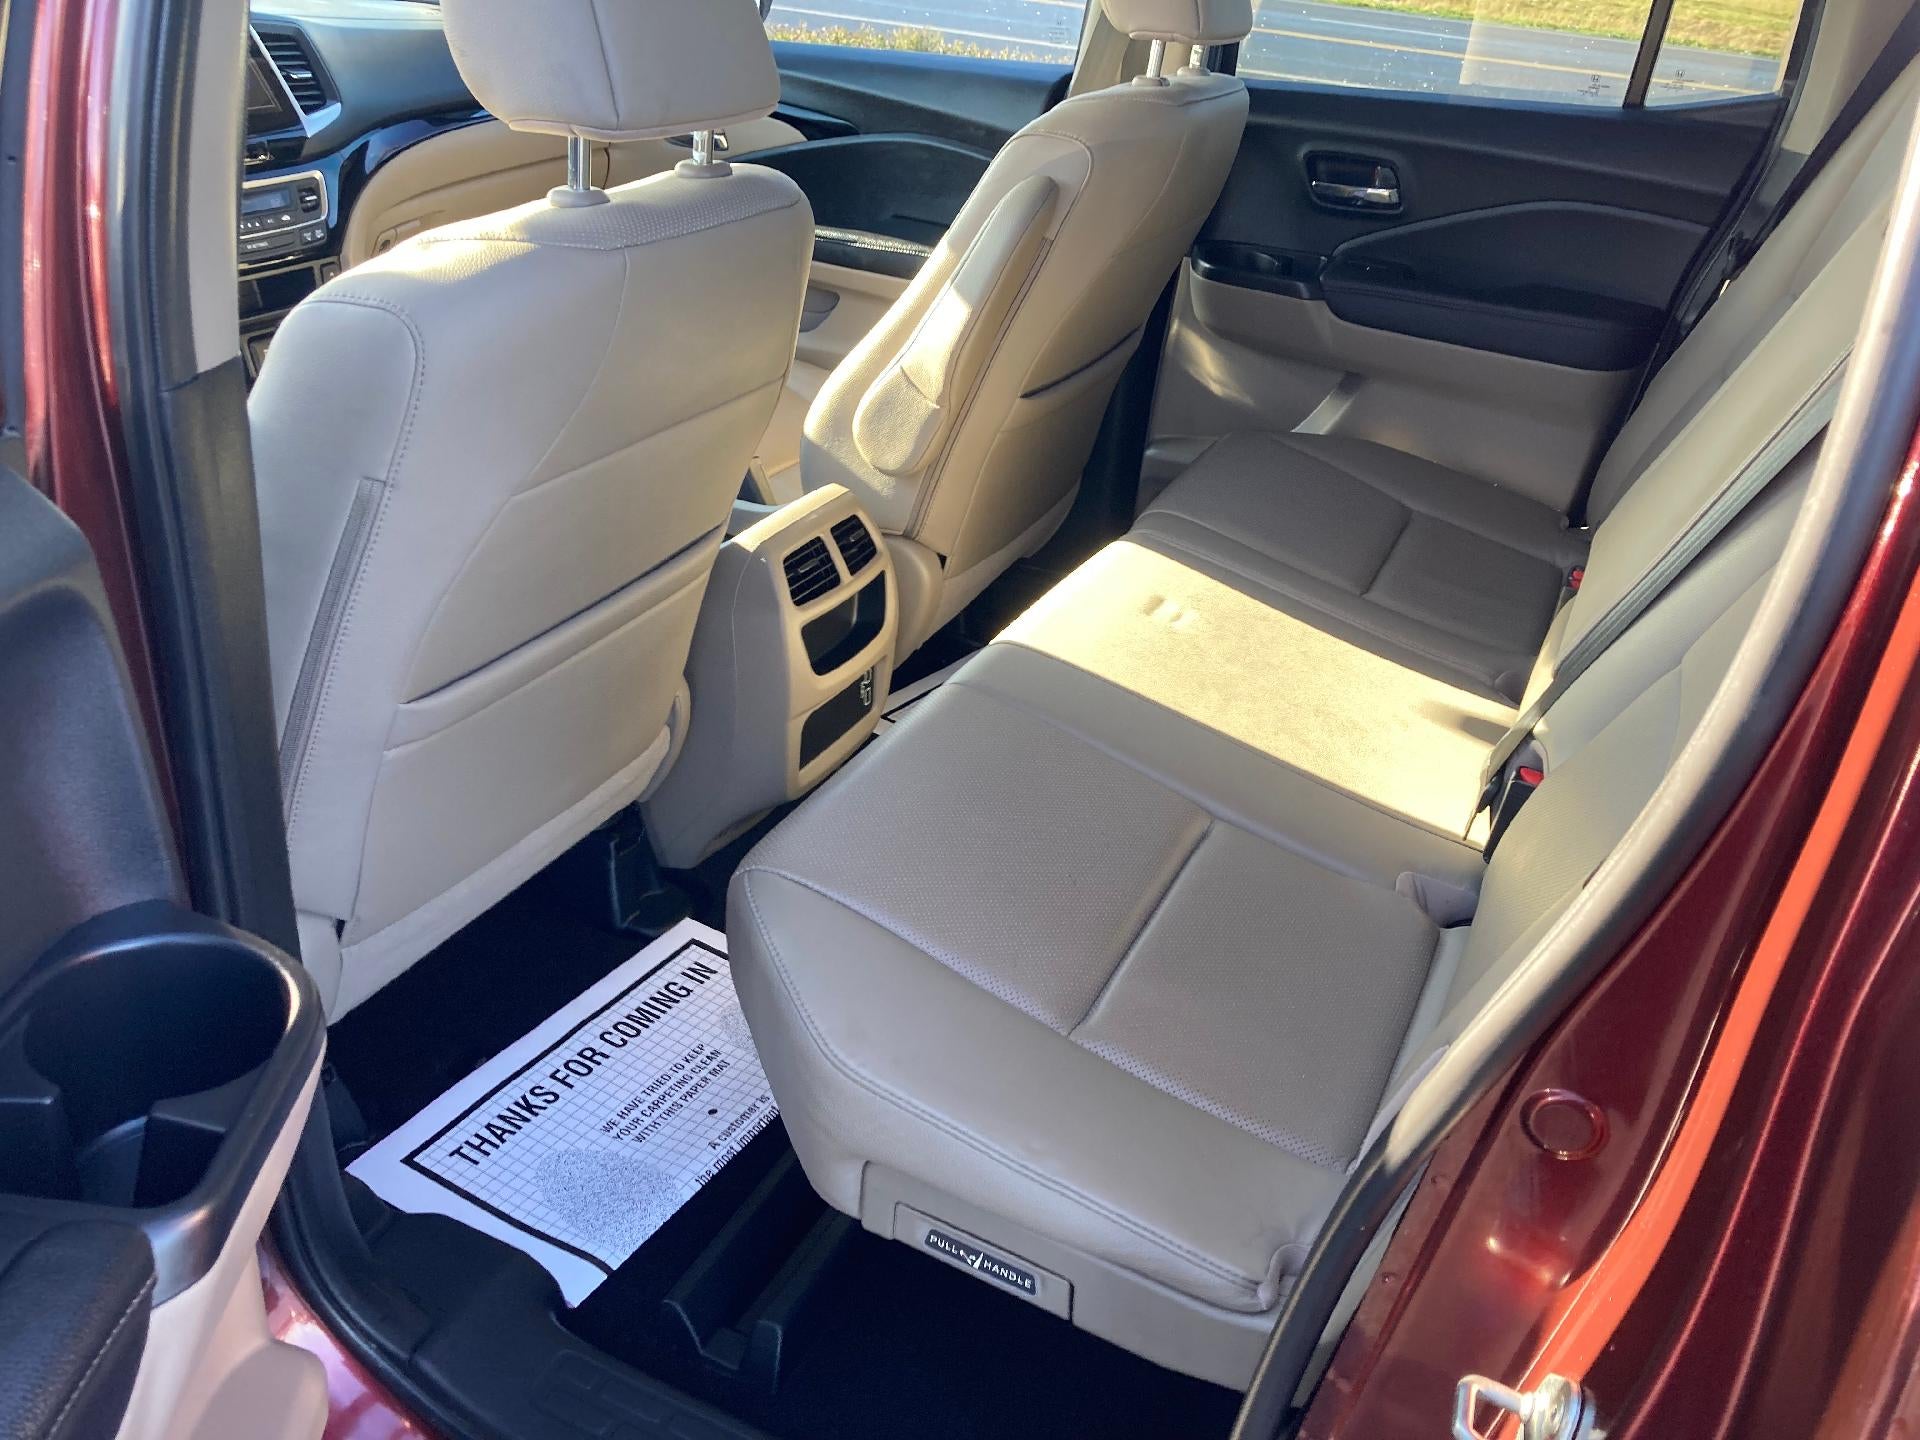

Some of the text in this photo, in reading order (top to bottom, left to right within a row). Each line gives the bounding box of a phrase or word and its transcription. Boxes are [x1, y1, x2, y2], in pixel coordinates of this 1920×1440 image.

[450, 961, 718, 1165] THANKS FOR COMING IN
[600, 1043, 706, 1133] WE HAVE TRIED TO KEEP
[612, 1049, 722, 1141] YOUR CARPETING CLEAN
[633, 1059, 730, 1143] WITH THIS PAPER MAT
[695, 1105, 780, 1185] the most important
[708, 1094, 770, 1150] A customer is
[930, 1234, 1032, 1289] PULL HANDLE
